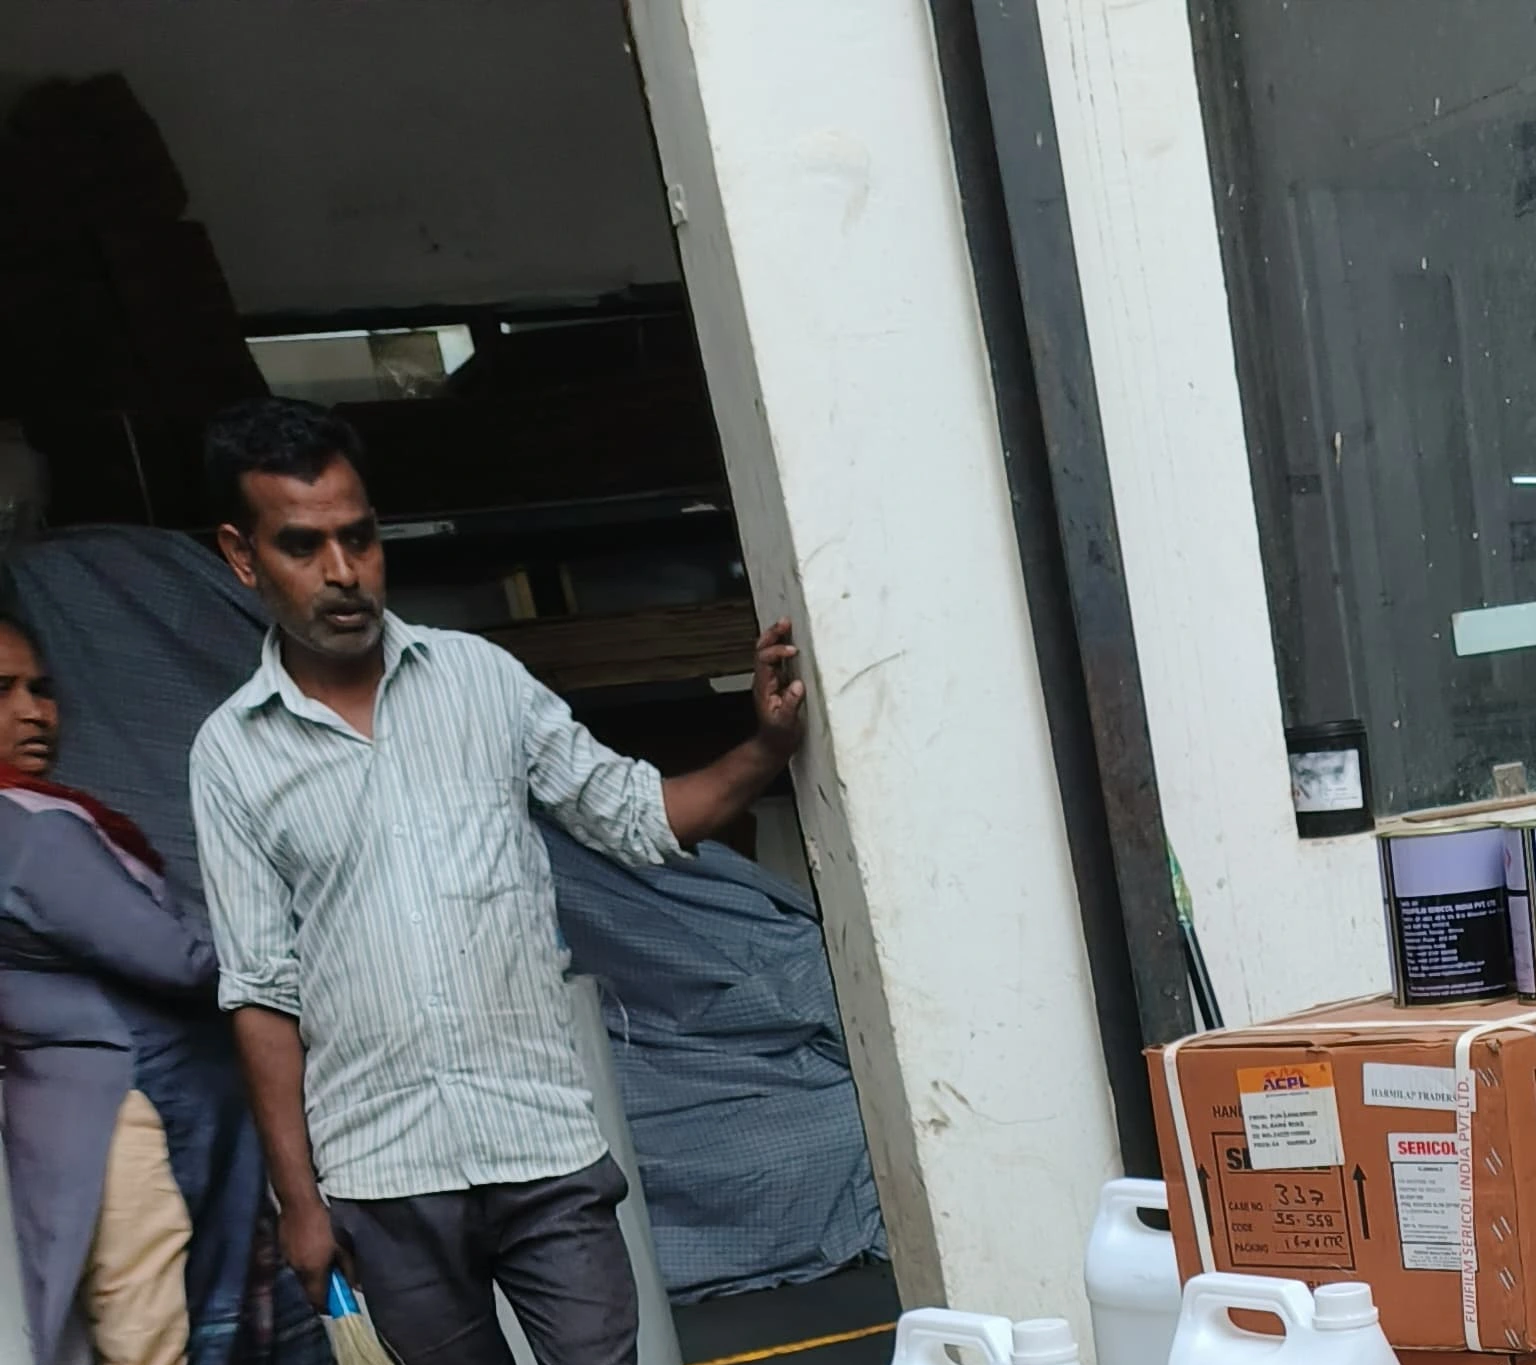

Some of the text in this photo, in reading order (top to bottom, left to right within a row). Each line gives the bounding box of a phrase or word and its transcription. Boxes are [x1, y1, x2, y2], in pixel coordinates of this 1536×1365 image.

[1263, 1075, 1310, 1091] ACPL
[1212, 1104, 1243, 1118] HAN
[1397, 1140, 1459, 1156] SERICOL
[1459, 1147, 1472, 1192] INDIA
[1461, 1195, 1474, 1257] SERICOL
[1465, 1260, 1477, 1324] FUJIFILM
